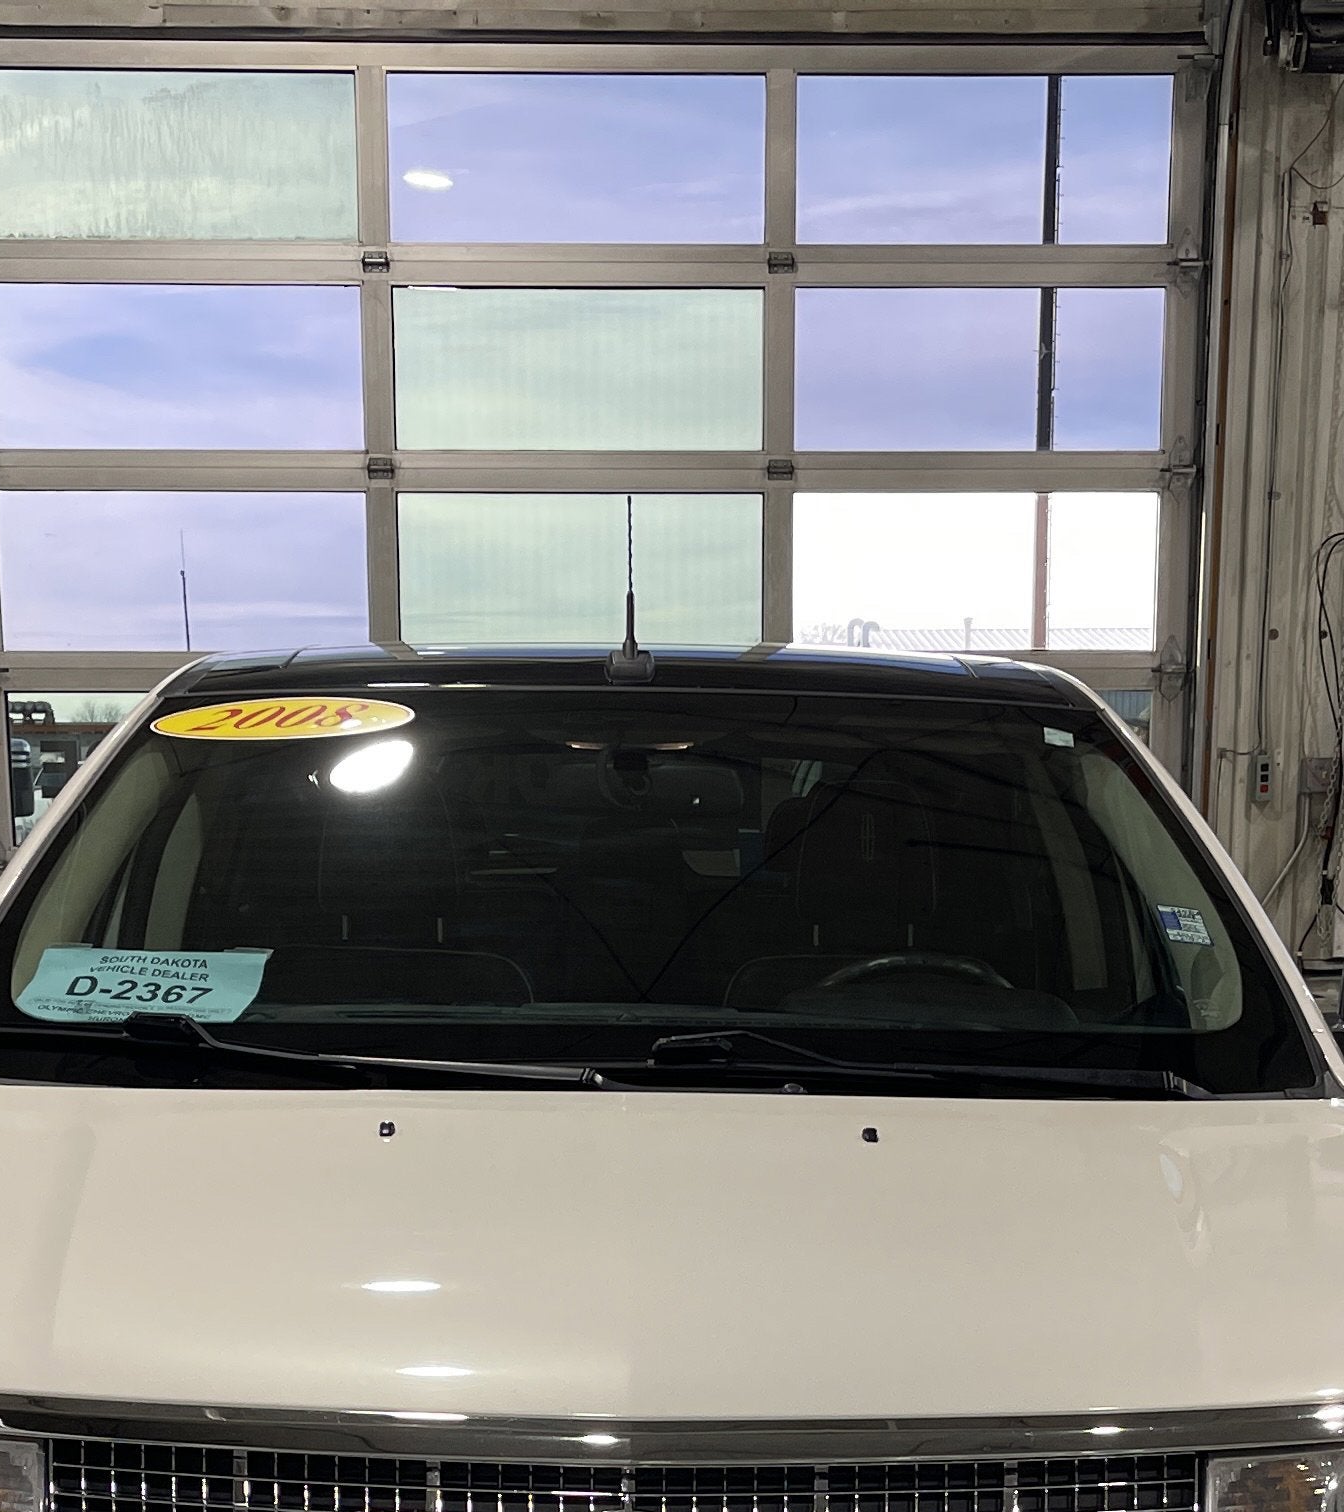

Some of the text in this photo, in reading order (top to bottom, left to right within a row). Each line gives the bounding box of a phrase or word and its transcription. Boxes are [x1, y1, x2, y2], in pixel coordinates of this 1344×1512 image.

[184, 703, 370, 733] 2008
[89, 965, 209, 983] VEHICLE DEALER
[99, 955, 208, 970] SOUTH DAKOTA
[65, 975, 214, 1005] D-2367
